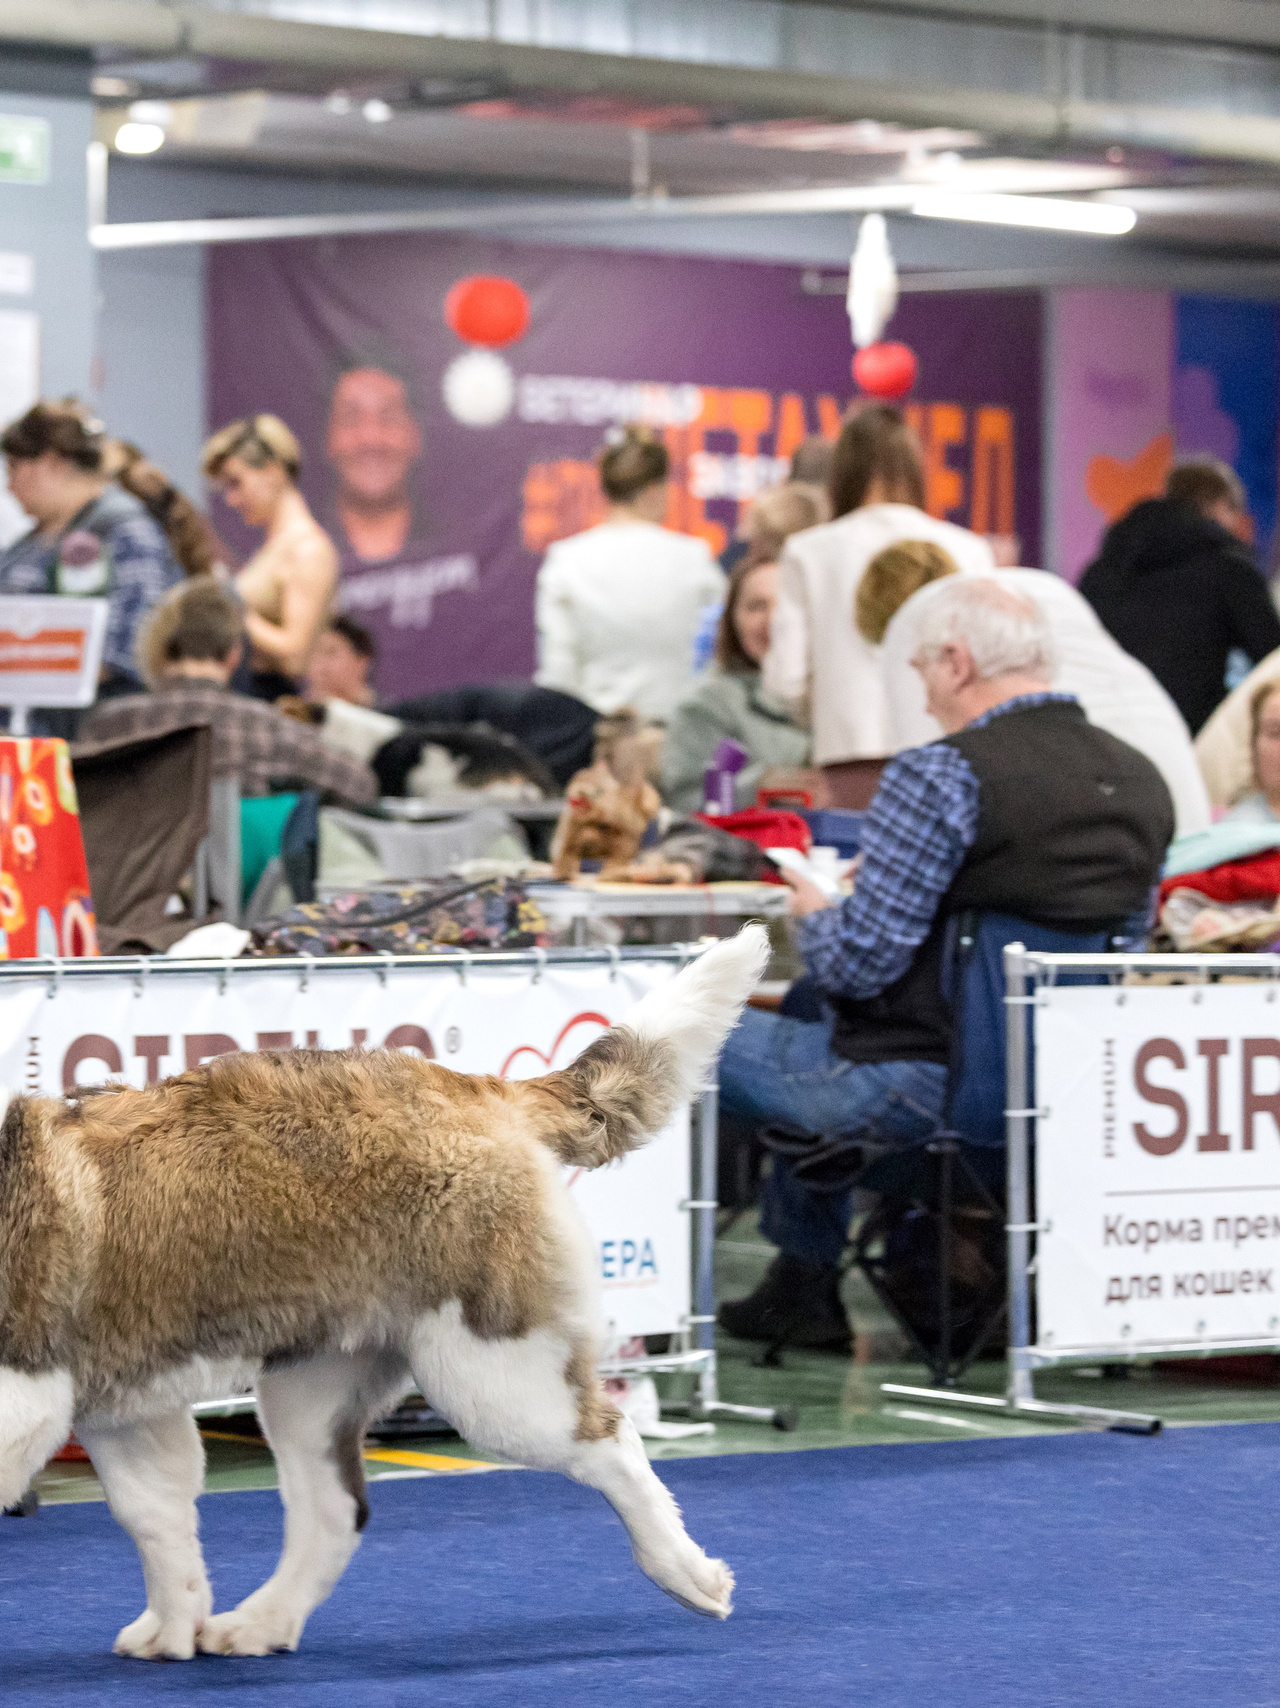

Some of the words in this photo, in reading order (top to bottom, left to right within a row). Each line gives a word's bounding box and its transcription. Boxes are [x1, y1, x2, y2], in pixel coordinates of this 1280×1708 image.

[1132, 1037, 1280, 1156] SIR
[1104, 1213, 1202, 1252] Корма
[1104, 1274, 1162, 1306] для
[1173, 1266, 1274, 1297] кошек
